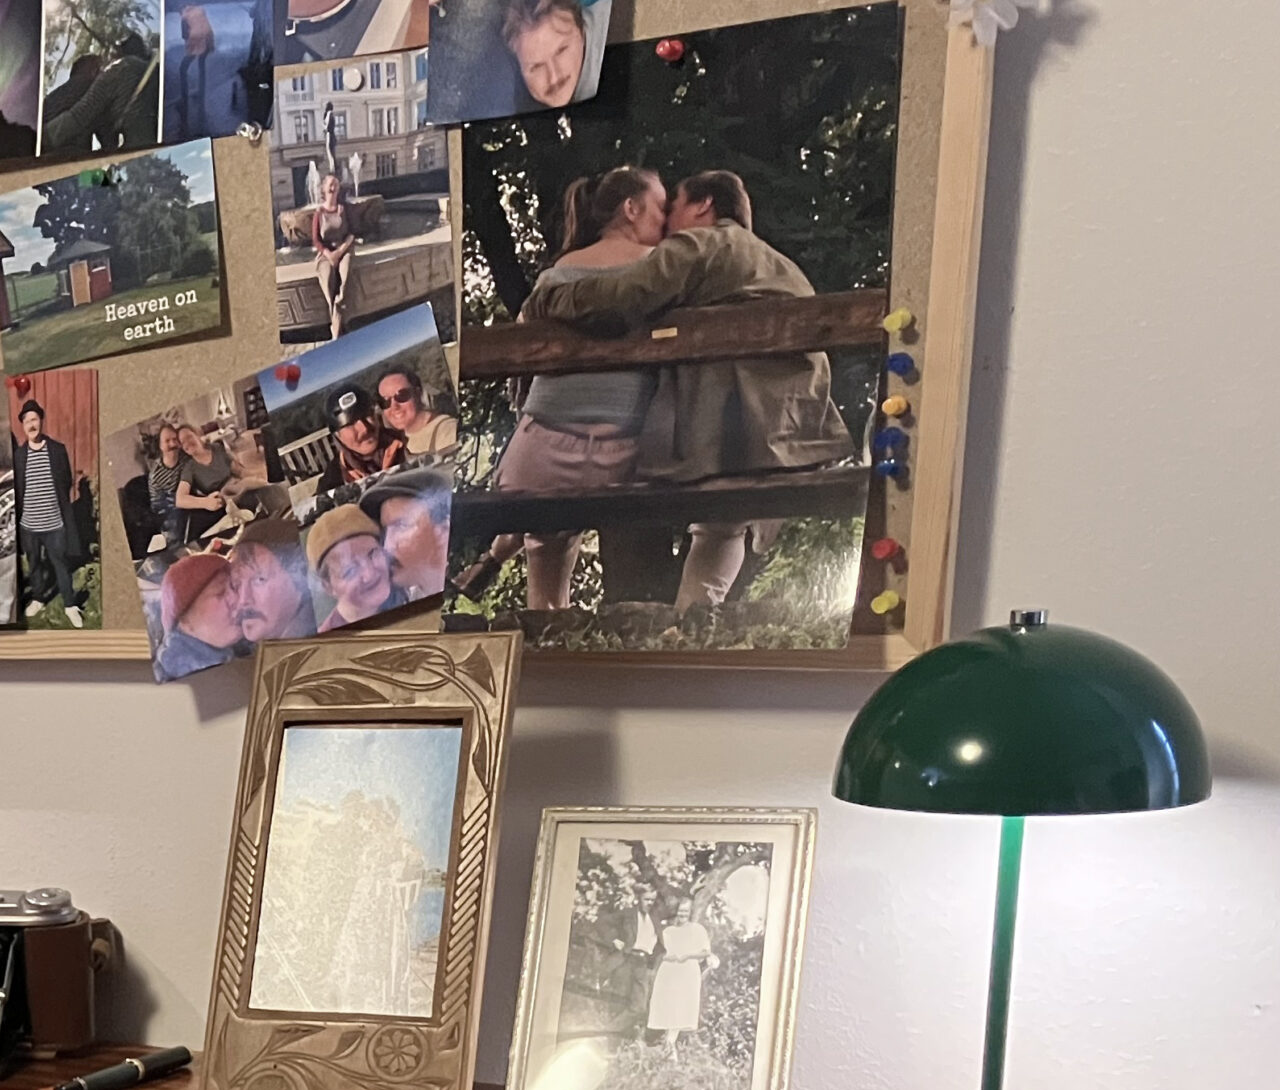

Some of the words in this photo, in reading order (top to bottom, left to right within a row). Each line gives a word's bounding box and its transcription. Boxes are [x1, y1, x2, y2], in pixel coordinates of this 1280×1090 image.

[105, 296, 170, 322] Heaven
[175, 289, 198, 306] on
[123, 315, 175, 340] earth
